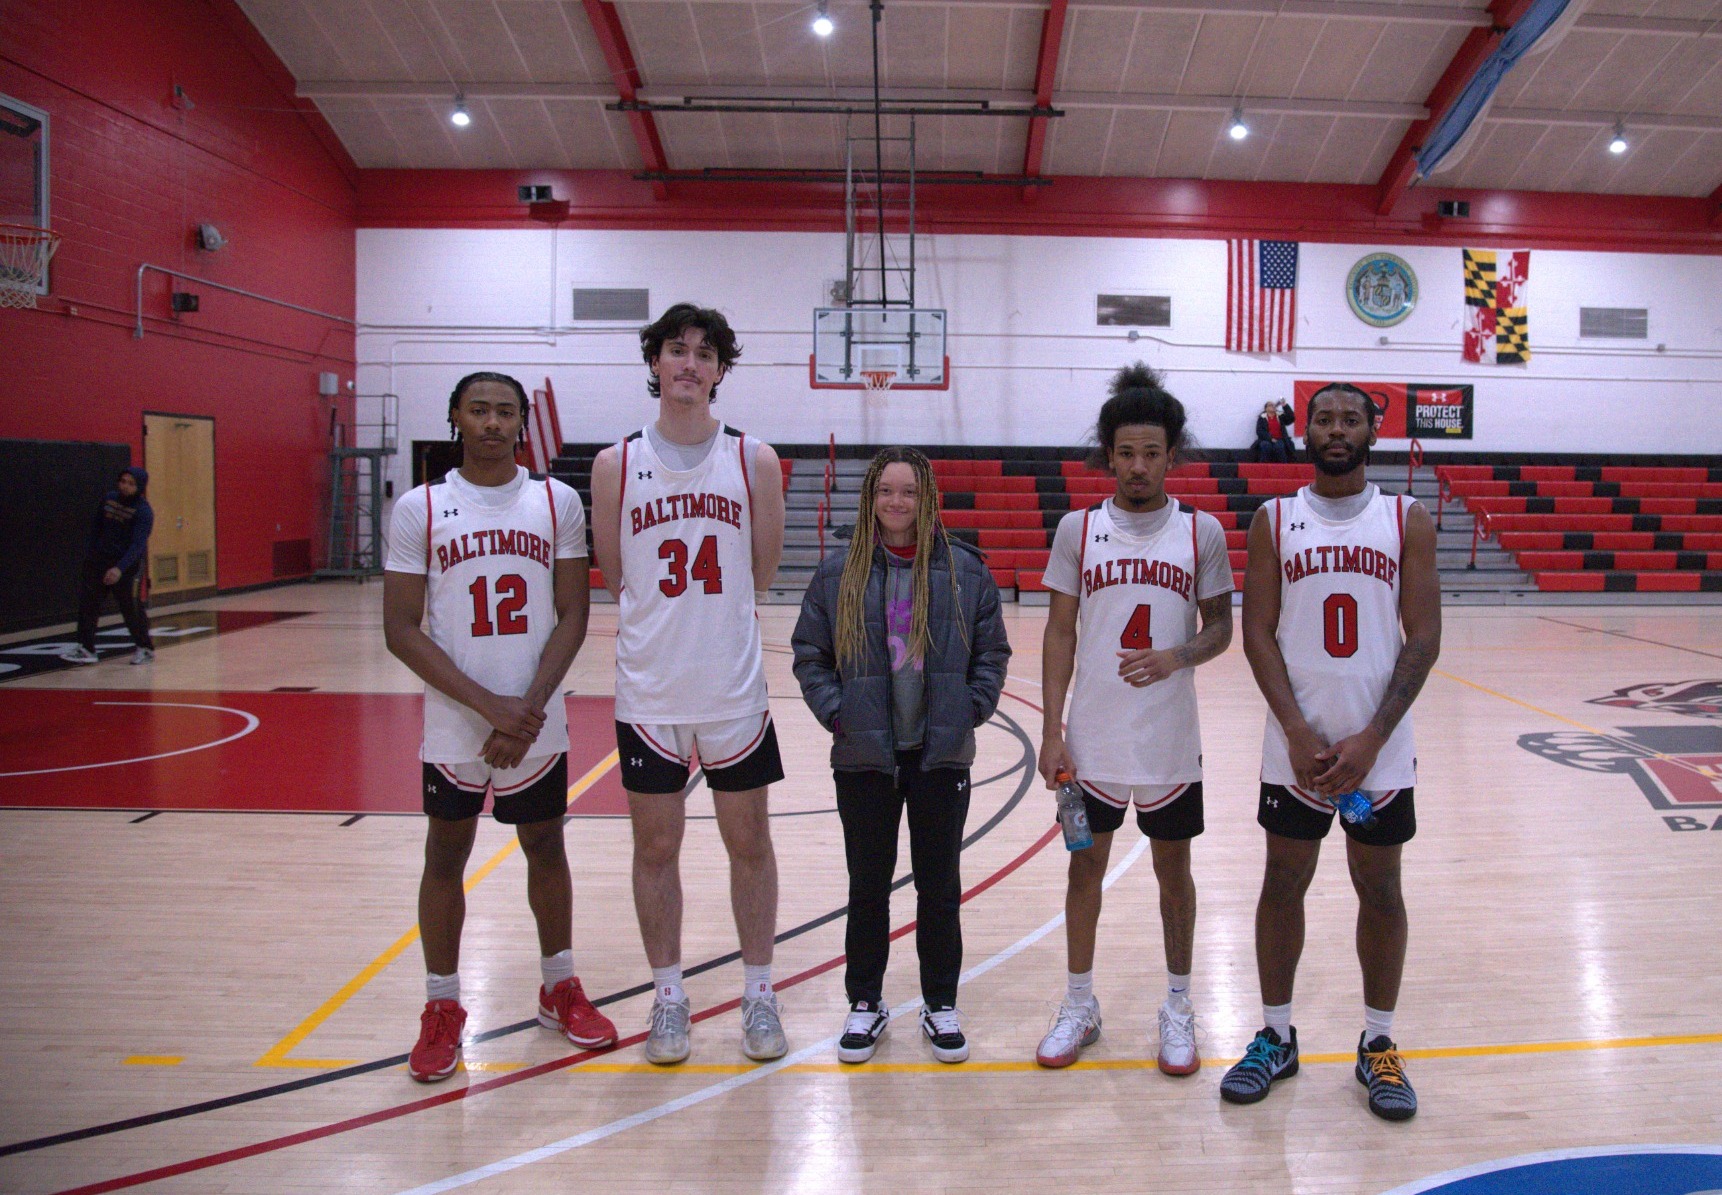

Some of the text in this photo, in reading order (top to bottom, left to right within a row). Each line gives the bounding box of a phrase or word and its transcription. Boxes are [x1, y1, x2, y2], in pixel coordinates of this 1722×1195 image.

[1415, 405, 1461, 418] PROTECT
[1416, 419, 1433, 428] THIS
[630, 492, 742, 536] BALTIMORE
[437, 529, 551, 575] BALTIMORE
[658, 535, 723, 598] 34
[1284, 545, 1398, 591] BALTIMORE
[1083, 558, 1193, 602] BALTIMORE
[469, 574, 528, 637] 12
[1120, 604, 1152, 651] 4
[1323, 593, 1358, 658] 0
